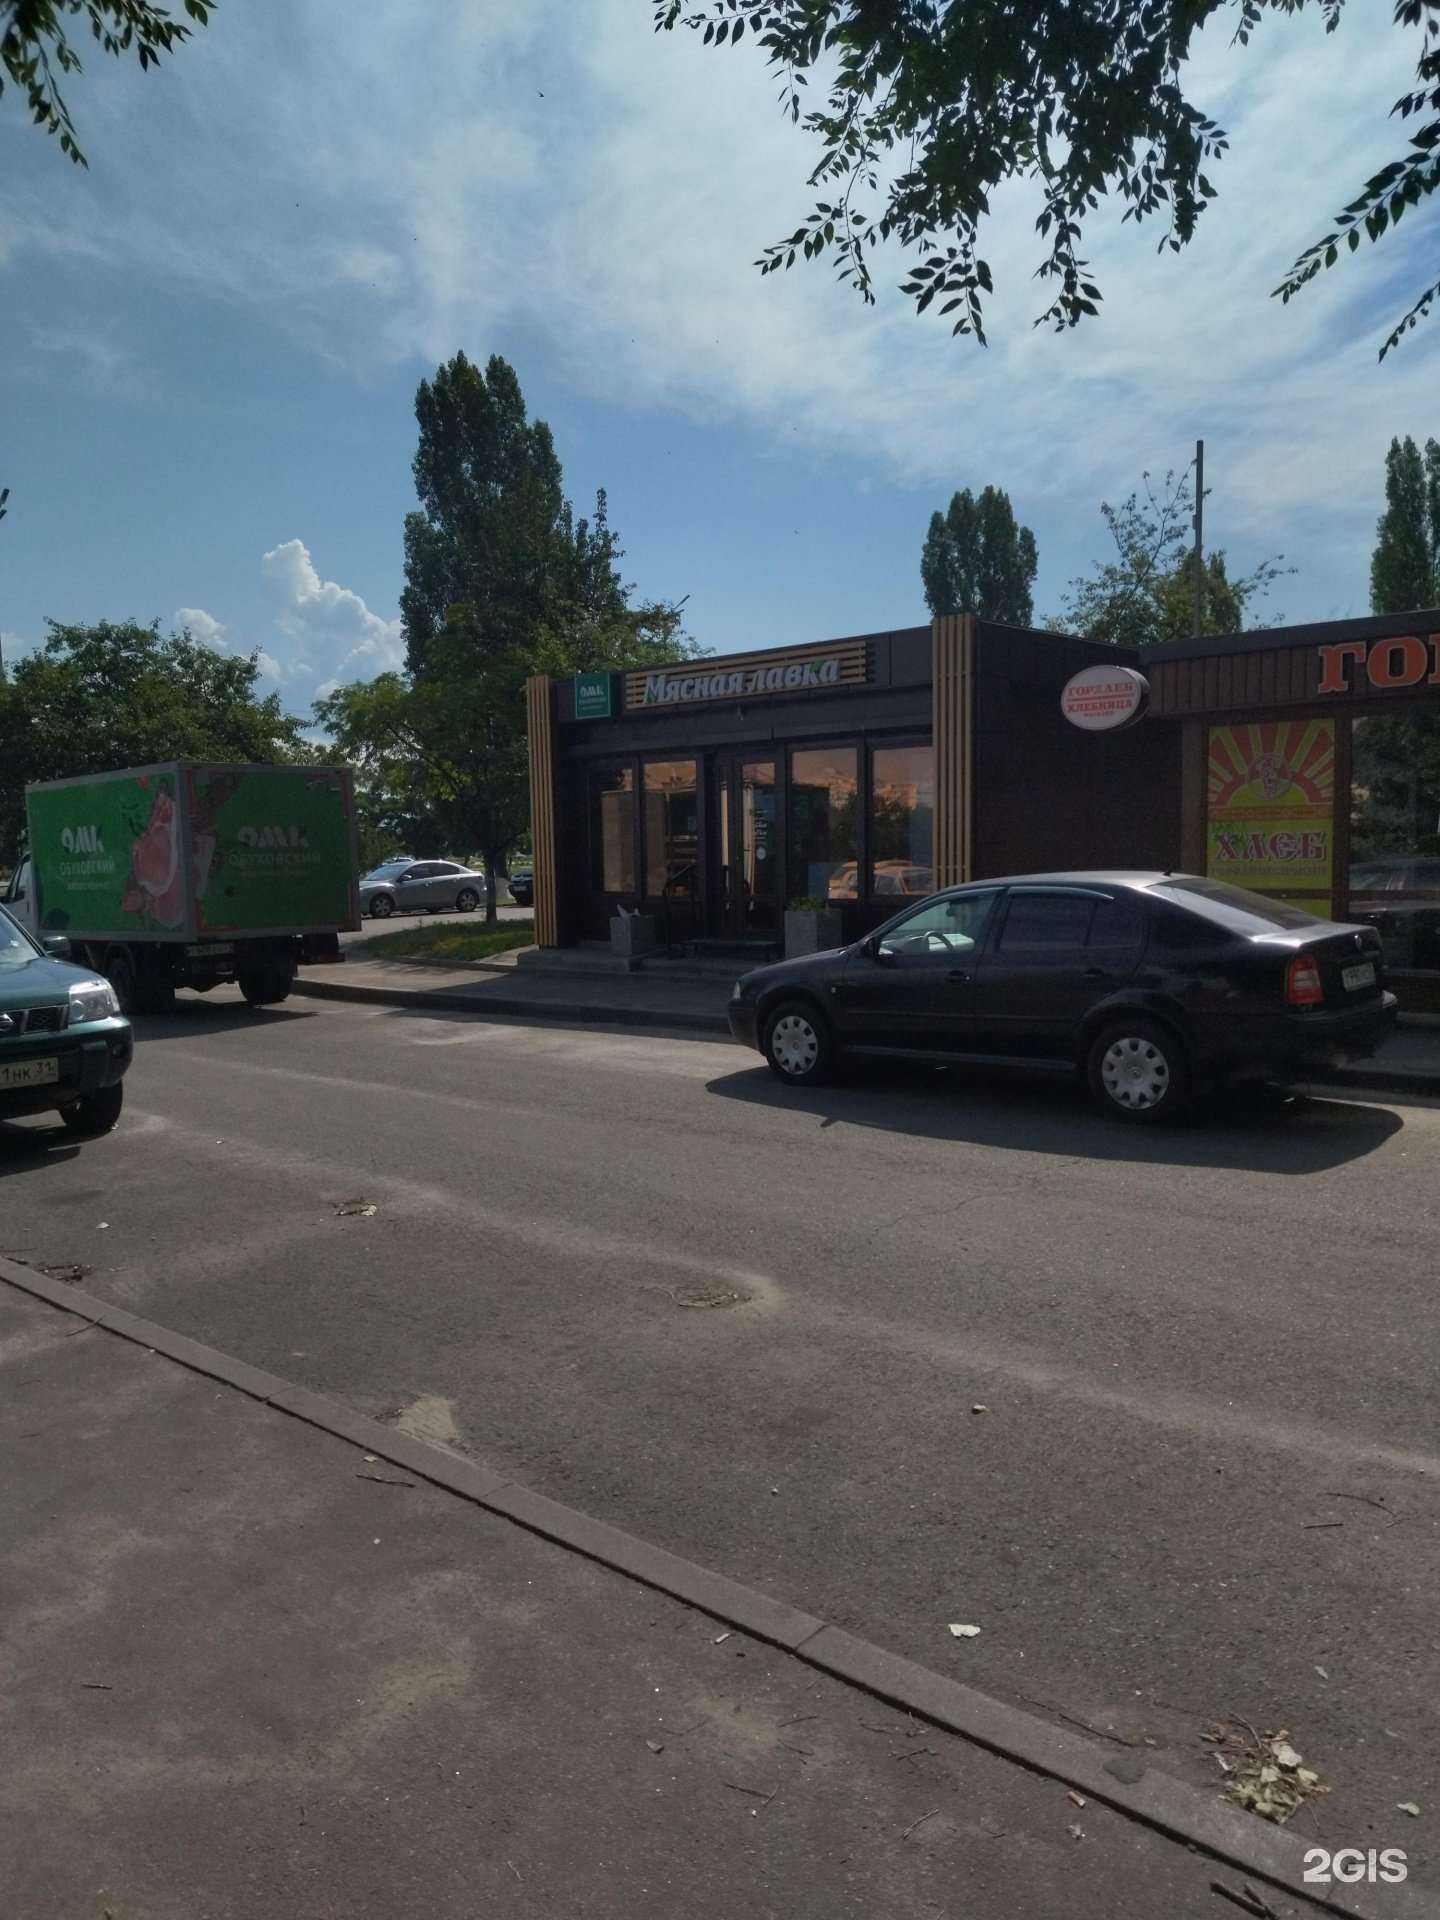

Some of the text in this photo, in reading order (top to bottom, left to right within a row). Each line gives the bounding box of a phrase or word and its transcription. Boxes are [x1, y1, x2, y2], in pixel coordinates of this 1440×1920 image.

[643, 658, 840, 704] Мясная лавка
[1318, 634, 1440, 693] ГО
[1066, 699, 1134, 714] ХЛЕБНИЦА
[1215, 832, 1327, 861] ХЛЕБ
